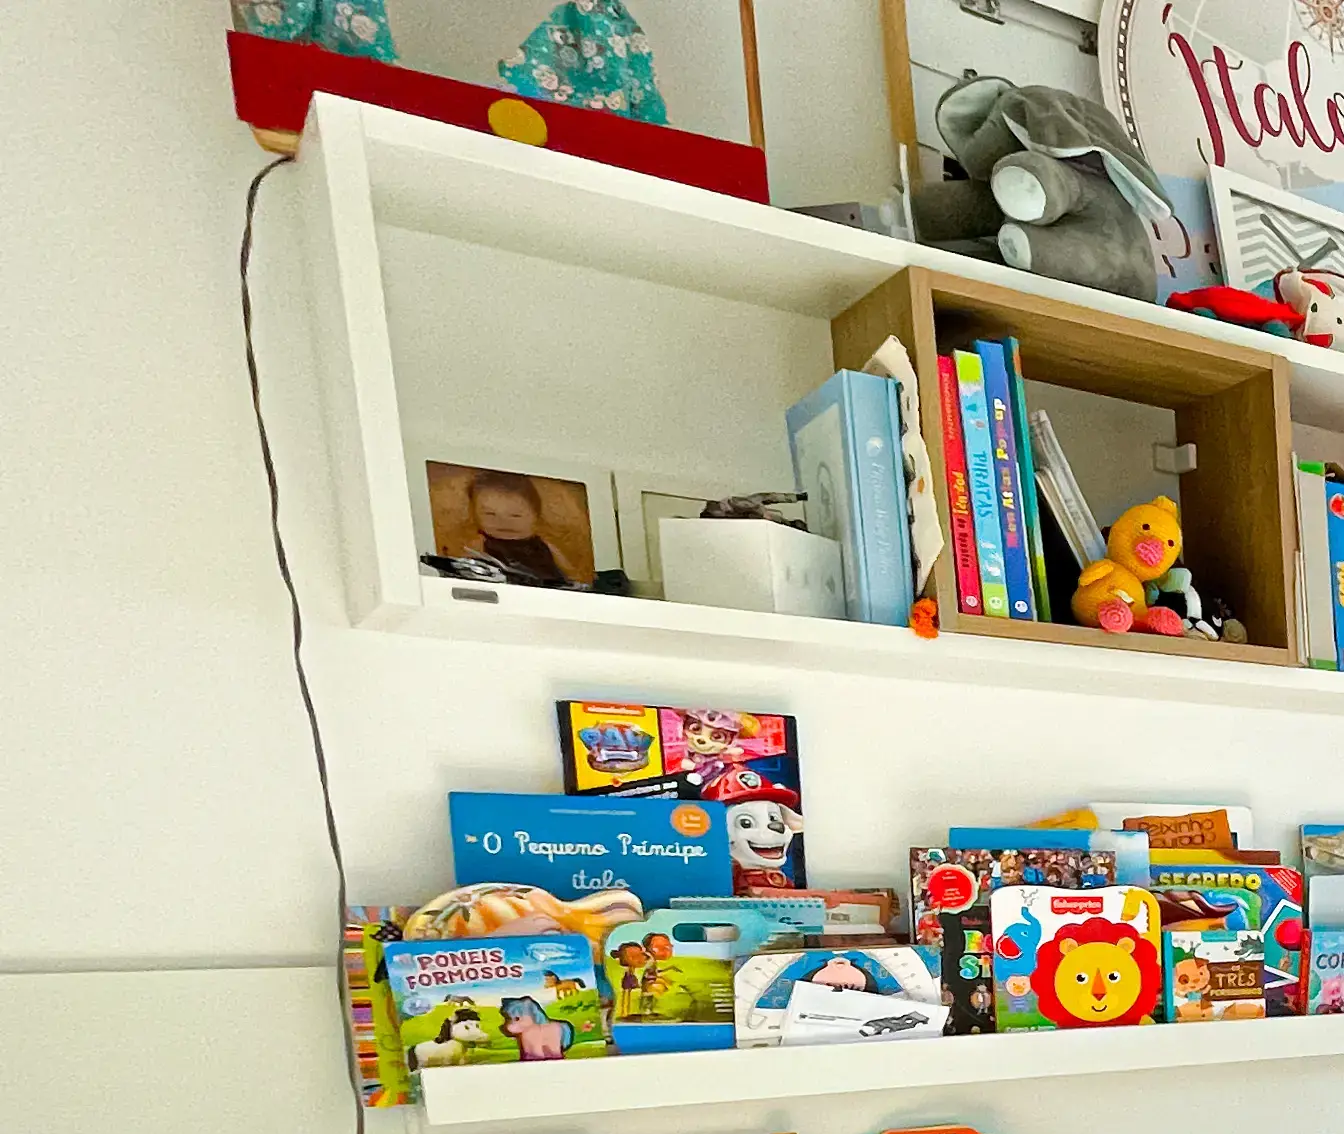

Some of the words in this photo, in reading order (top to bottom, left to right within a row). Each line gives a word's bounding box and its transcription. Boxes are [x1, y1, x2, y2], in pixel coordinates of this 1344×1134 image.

[971, 449, 994, 519] PIRATAS
[483, 831, 502, 855] O
[514, 830, 610, 863] Pequeno
[405, 964, 524, 990] FORMOSOS
